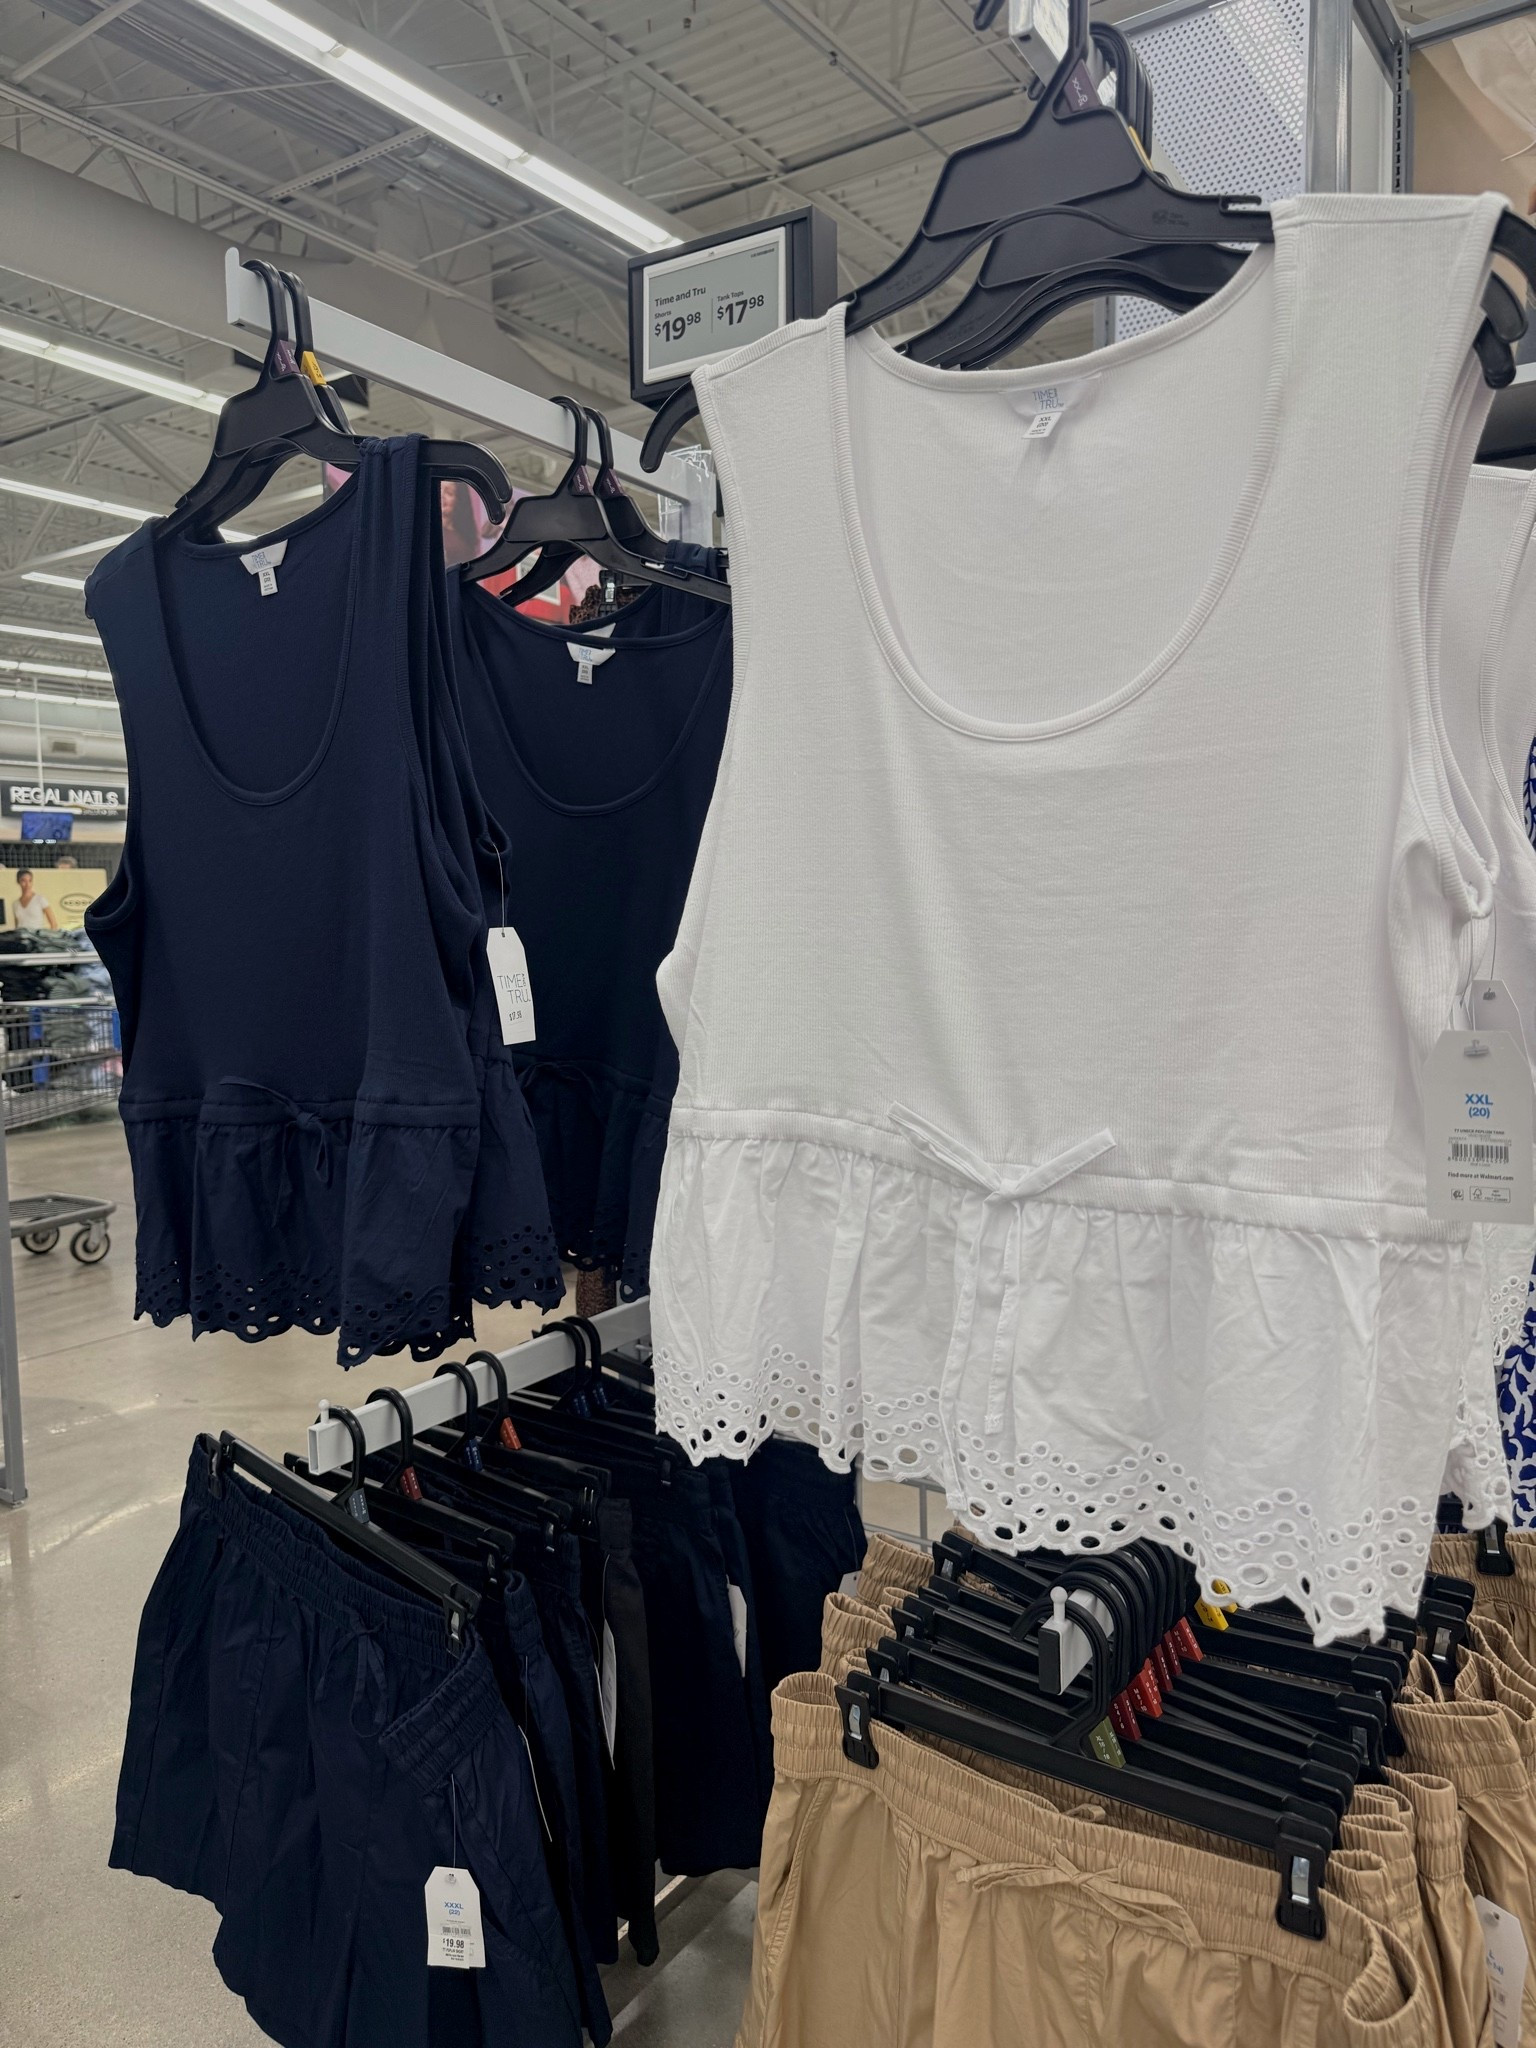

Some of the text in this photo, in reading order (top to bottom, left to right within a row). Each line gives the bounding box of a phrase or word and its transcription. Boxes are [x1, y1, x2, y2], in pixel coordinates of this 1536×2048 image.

[654, 286, 706, 308] Time and Tru
[717, 290, 744, 303] Tank Tops
[654, 310, 672, 320] Shorts
[10, 786, 119, 808] REGAL NAILS
[496, 973, 523, 990] TIME
[1465, 1093, 1493, 1106] XXL
[1468, 1107, 1490, 1119] (20)
[1480, 1173, 1514, 1181] Walmart.com
[444, 1902, 464, 1910] XXXL
[442, 1938, 465, 1949] $19.98
